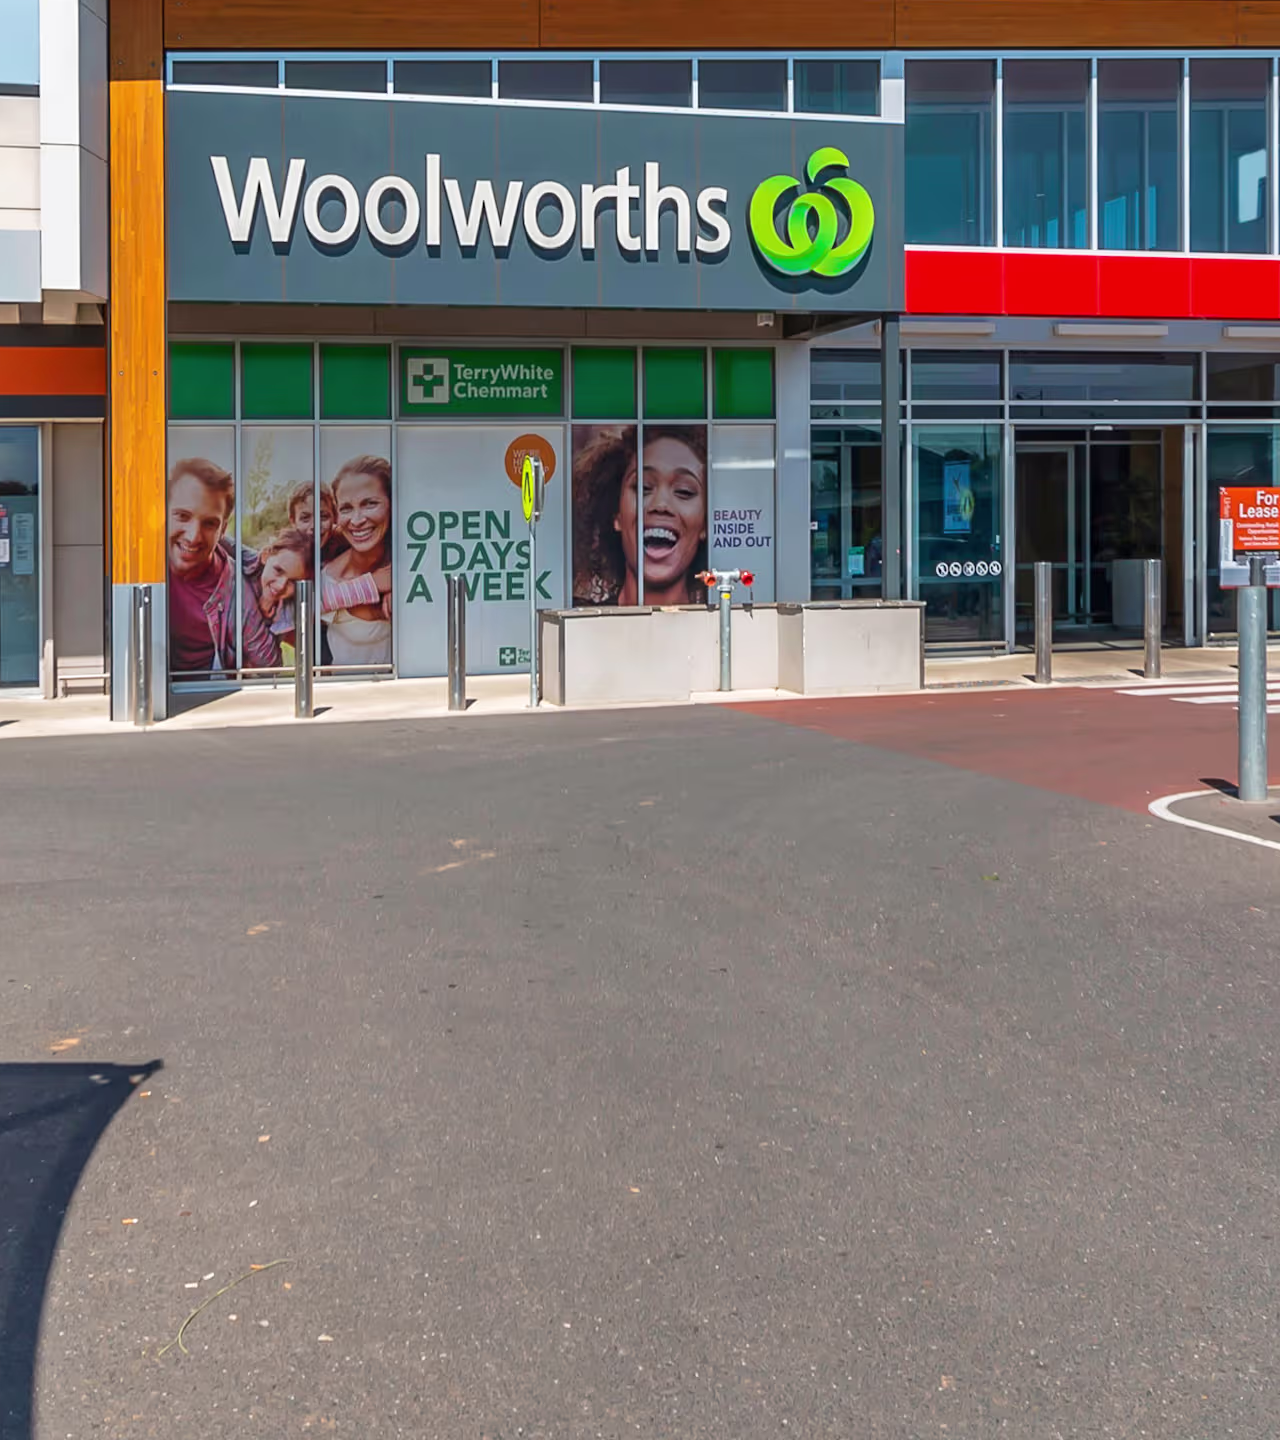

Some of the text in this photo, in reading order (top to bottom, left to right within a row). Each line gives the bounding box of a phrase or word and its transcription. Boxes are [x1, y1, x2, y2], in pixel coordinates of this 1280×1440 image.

[210, 153, 731, 255] Woolworths
[453, 363, 554, 385] TerryWhite
[453, 382, 548, 398] Chemmart
[1256, 490, 1279, 505] For
[713, 509, 762, 521] BEAUTY
[1239, 503, 1279, 518] Lease
[406, 510, 511, 541] OPEN
[713, 522, 755, 535] INSIDE
[713, 536, 772, 548] AND OUT
[406, 540, 532, 572] 7 DAYS
[406, 573, 433, 603] A
